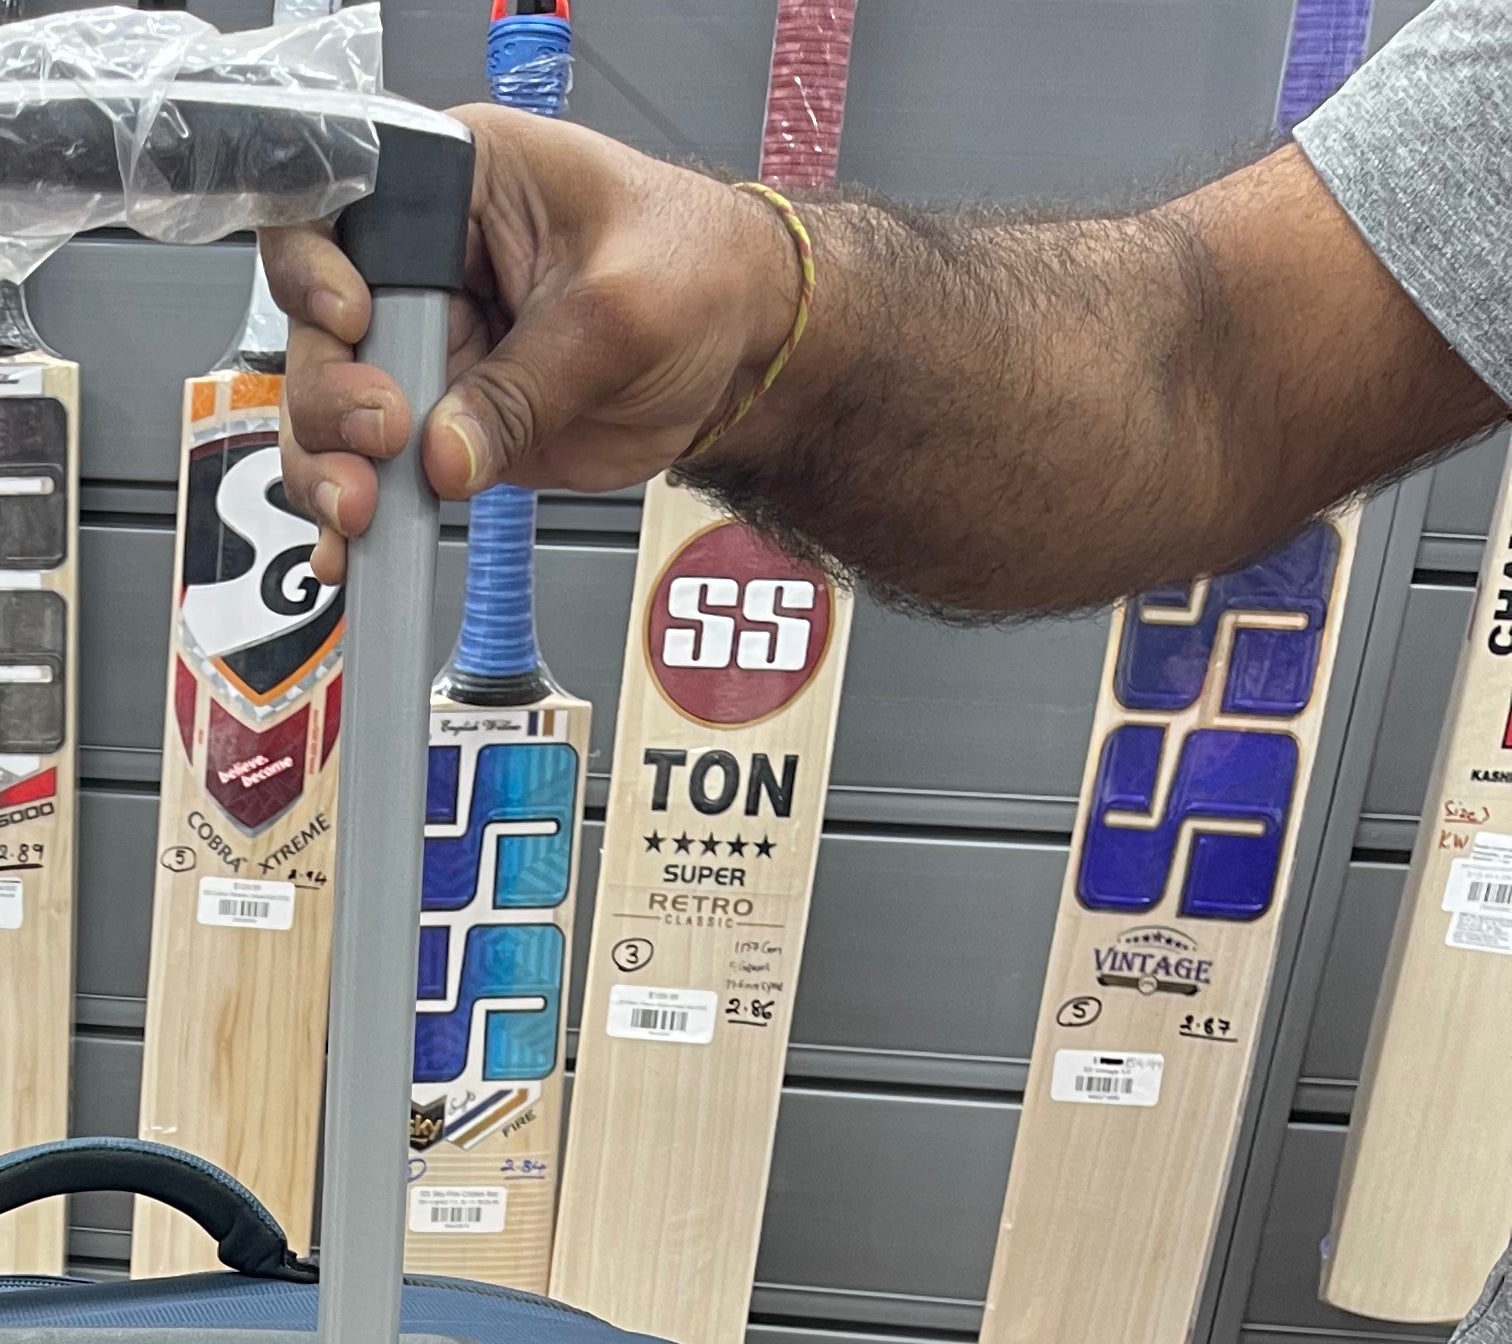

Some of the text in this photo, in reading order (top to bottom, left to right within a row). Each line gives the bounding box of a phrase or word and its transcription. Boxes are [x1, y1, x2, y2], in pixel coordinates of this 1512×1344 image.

[662, 576, 815, 672] SS
[643, 748, 800, 819] TON
[1470, 768, 1512, 784] KASH
[187, 810, 332, 875] COBRA XTREME
[174, 849, 186, 866] 5
[663, 863, 746, 887] SUPER
[648, 892, 754, 917] RETRO
[664, 914, 734, 929] CLASSIC
[624, 943, 640, 965] 3
[1094, 946, 1213, 985] VINTAGE
[725, 998, 775, 1020] 2.86
[501, 1108, 537, 1138] FIRE
